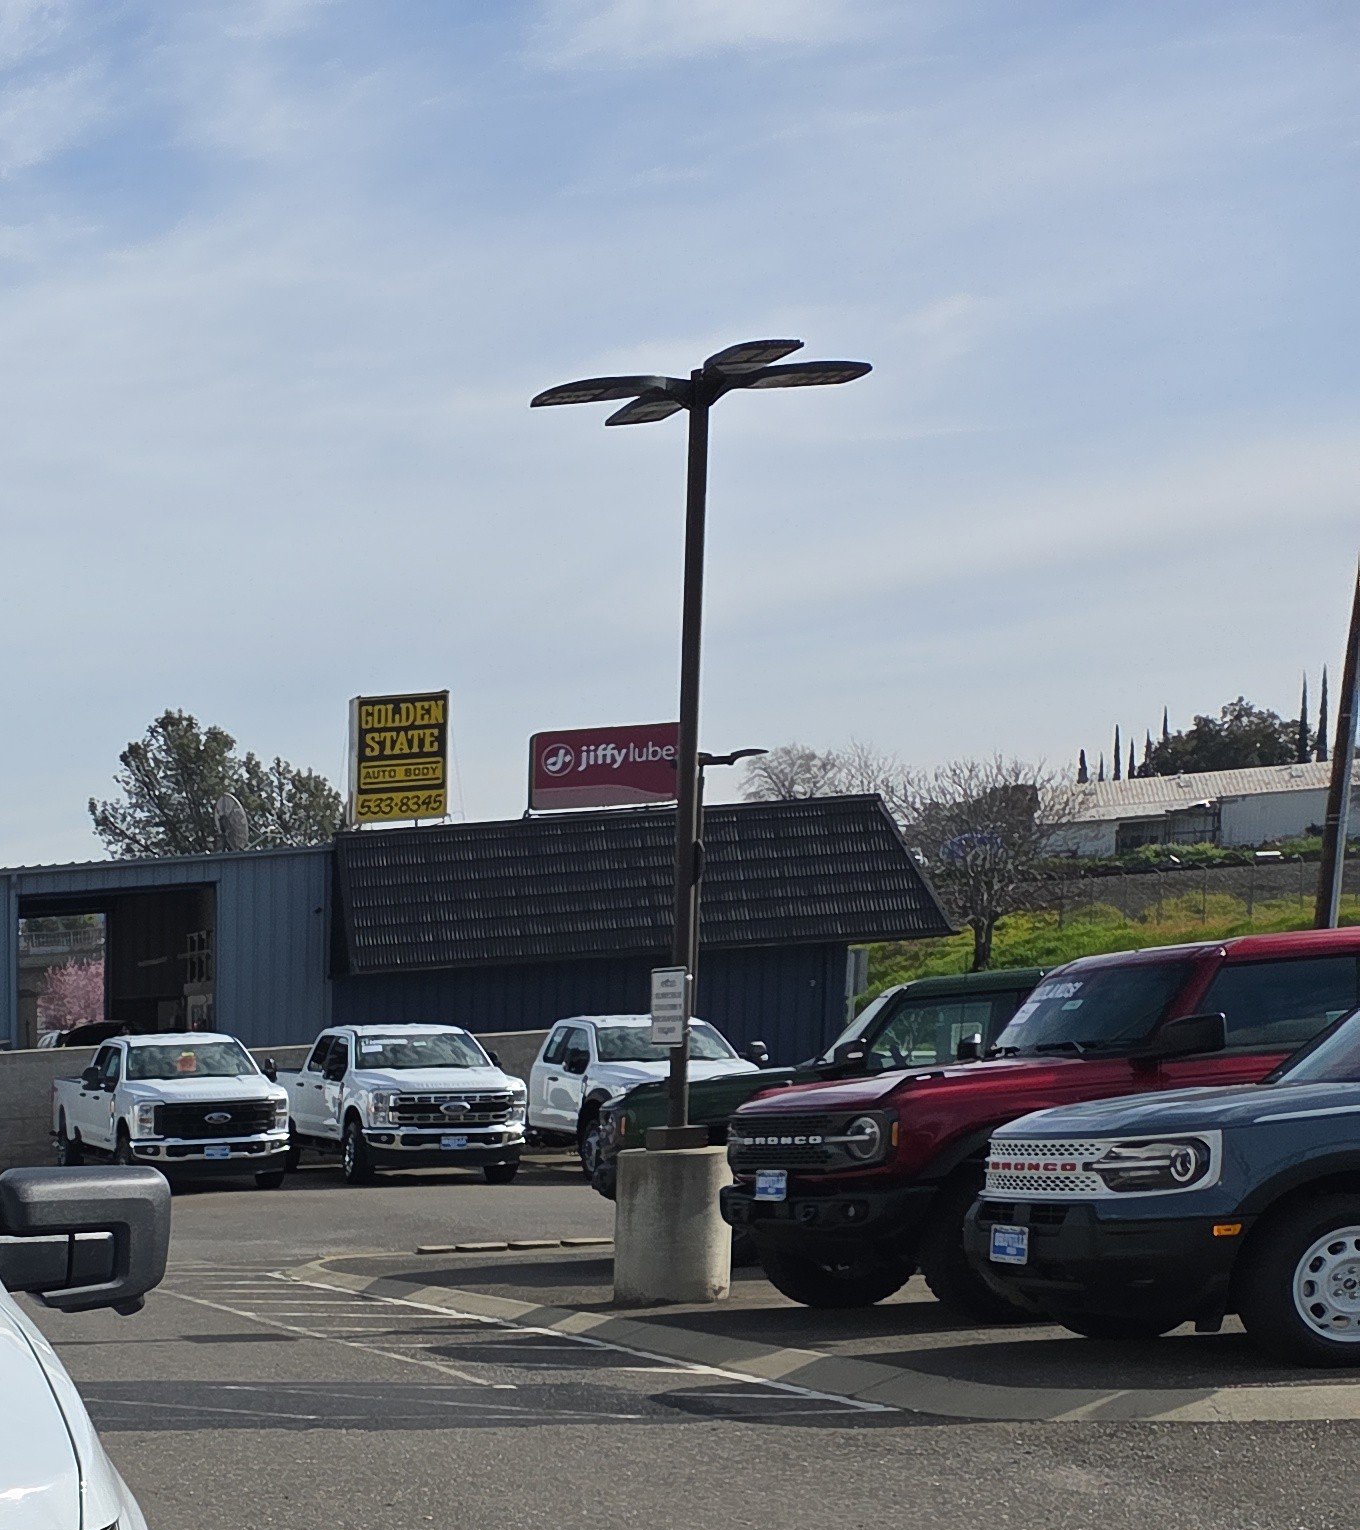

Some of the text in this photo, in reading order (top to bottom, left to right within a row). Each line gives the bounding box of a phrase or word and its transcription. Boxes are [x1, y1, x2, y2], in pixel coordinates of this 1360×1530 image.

[361, 700, 444, 729] GOLDEN
[365, 729, 439, 756] STATE
[363, 766, 438, 780] AUTO BODY
[744, 1136, 822, 1145] BRONCO
[991, 1162, 1077, 1172] BRONCO
